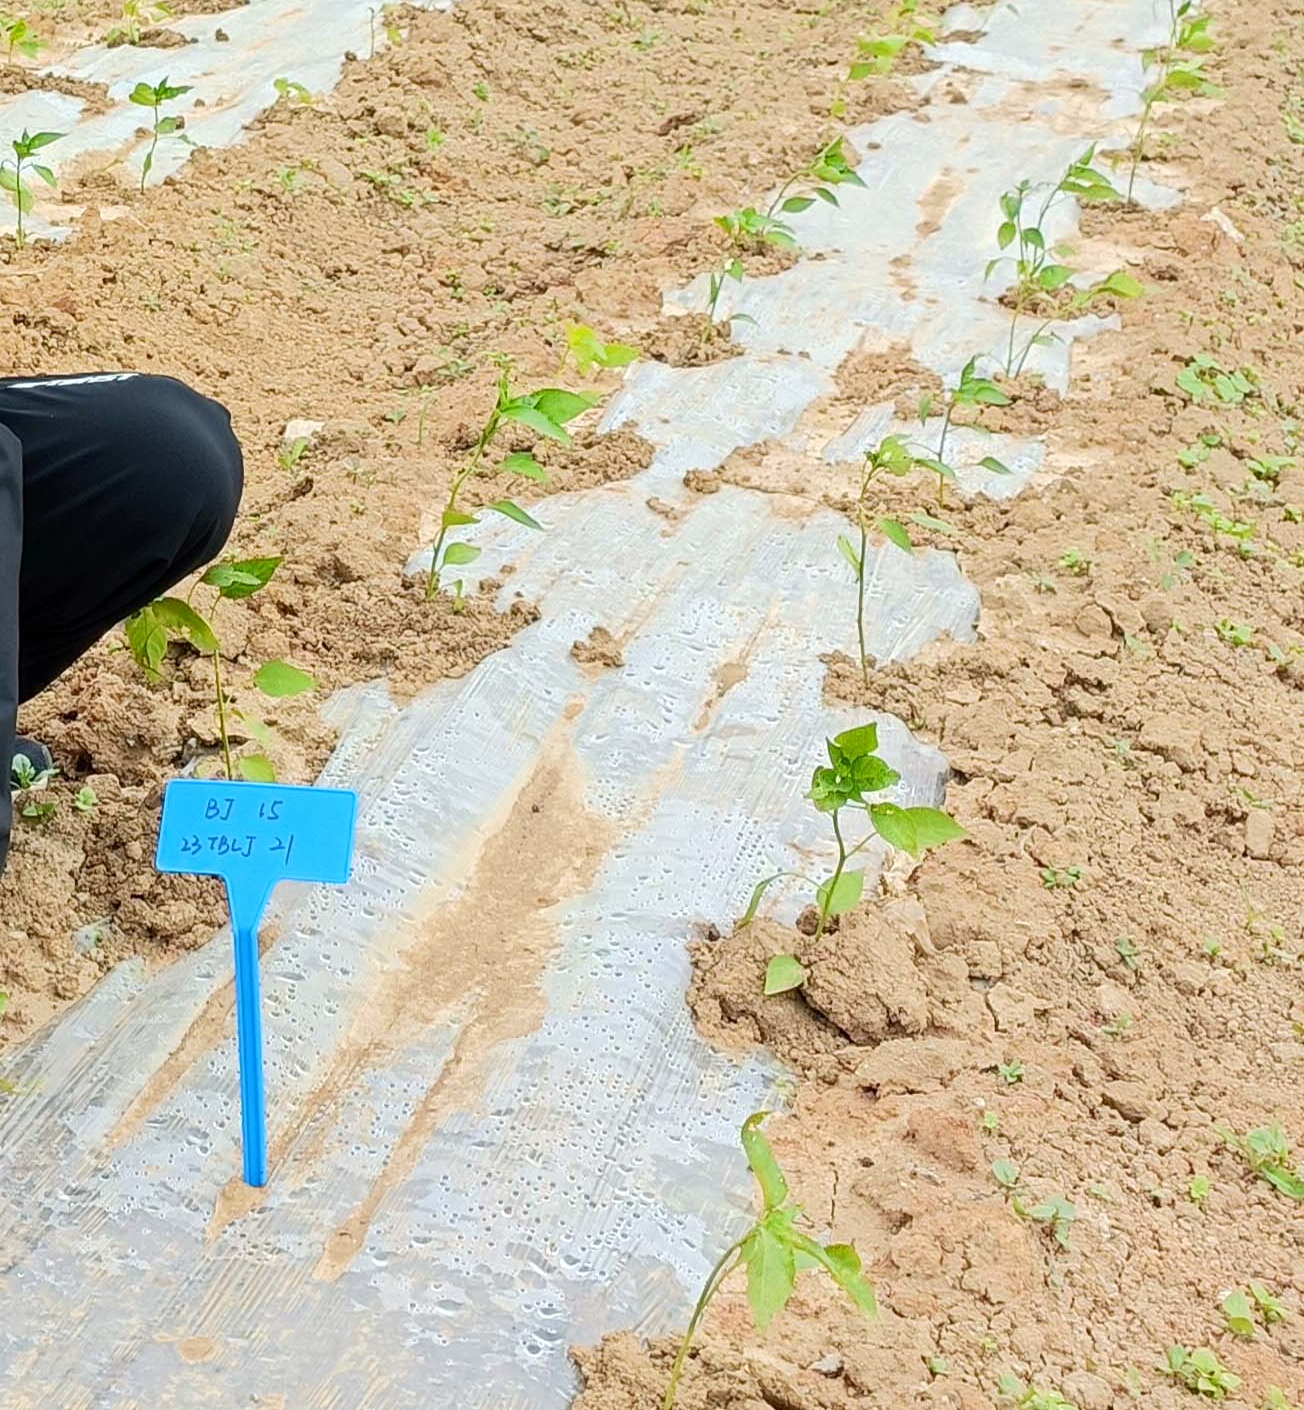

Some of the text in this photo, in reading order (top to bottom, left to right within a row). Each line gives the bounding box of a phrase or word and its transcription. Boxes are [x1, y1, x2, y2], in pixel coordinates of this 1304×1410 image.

[204, 797, 284, 821] BJ 15
[269, 833, 295, 866] 21
